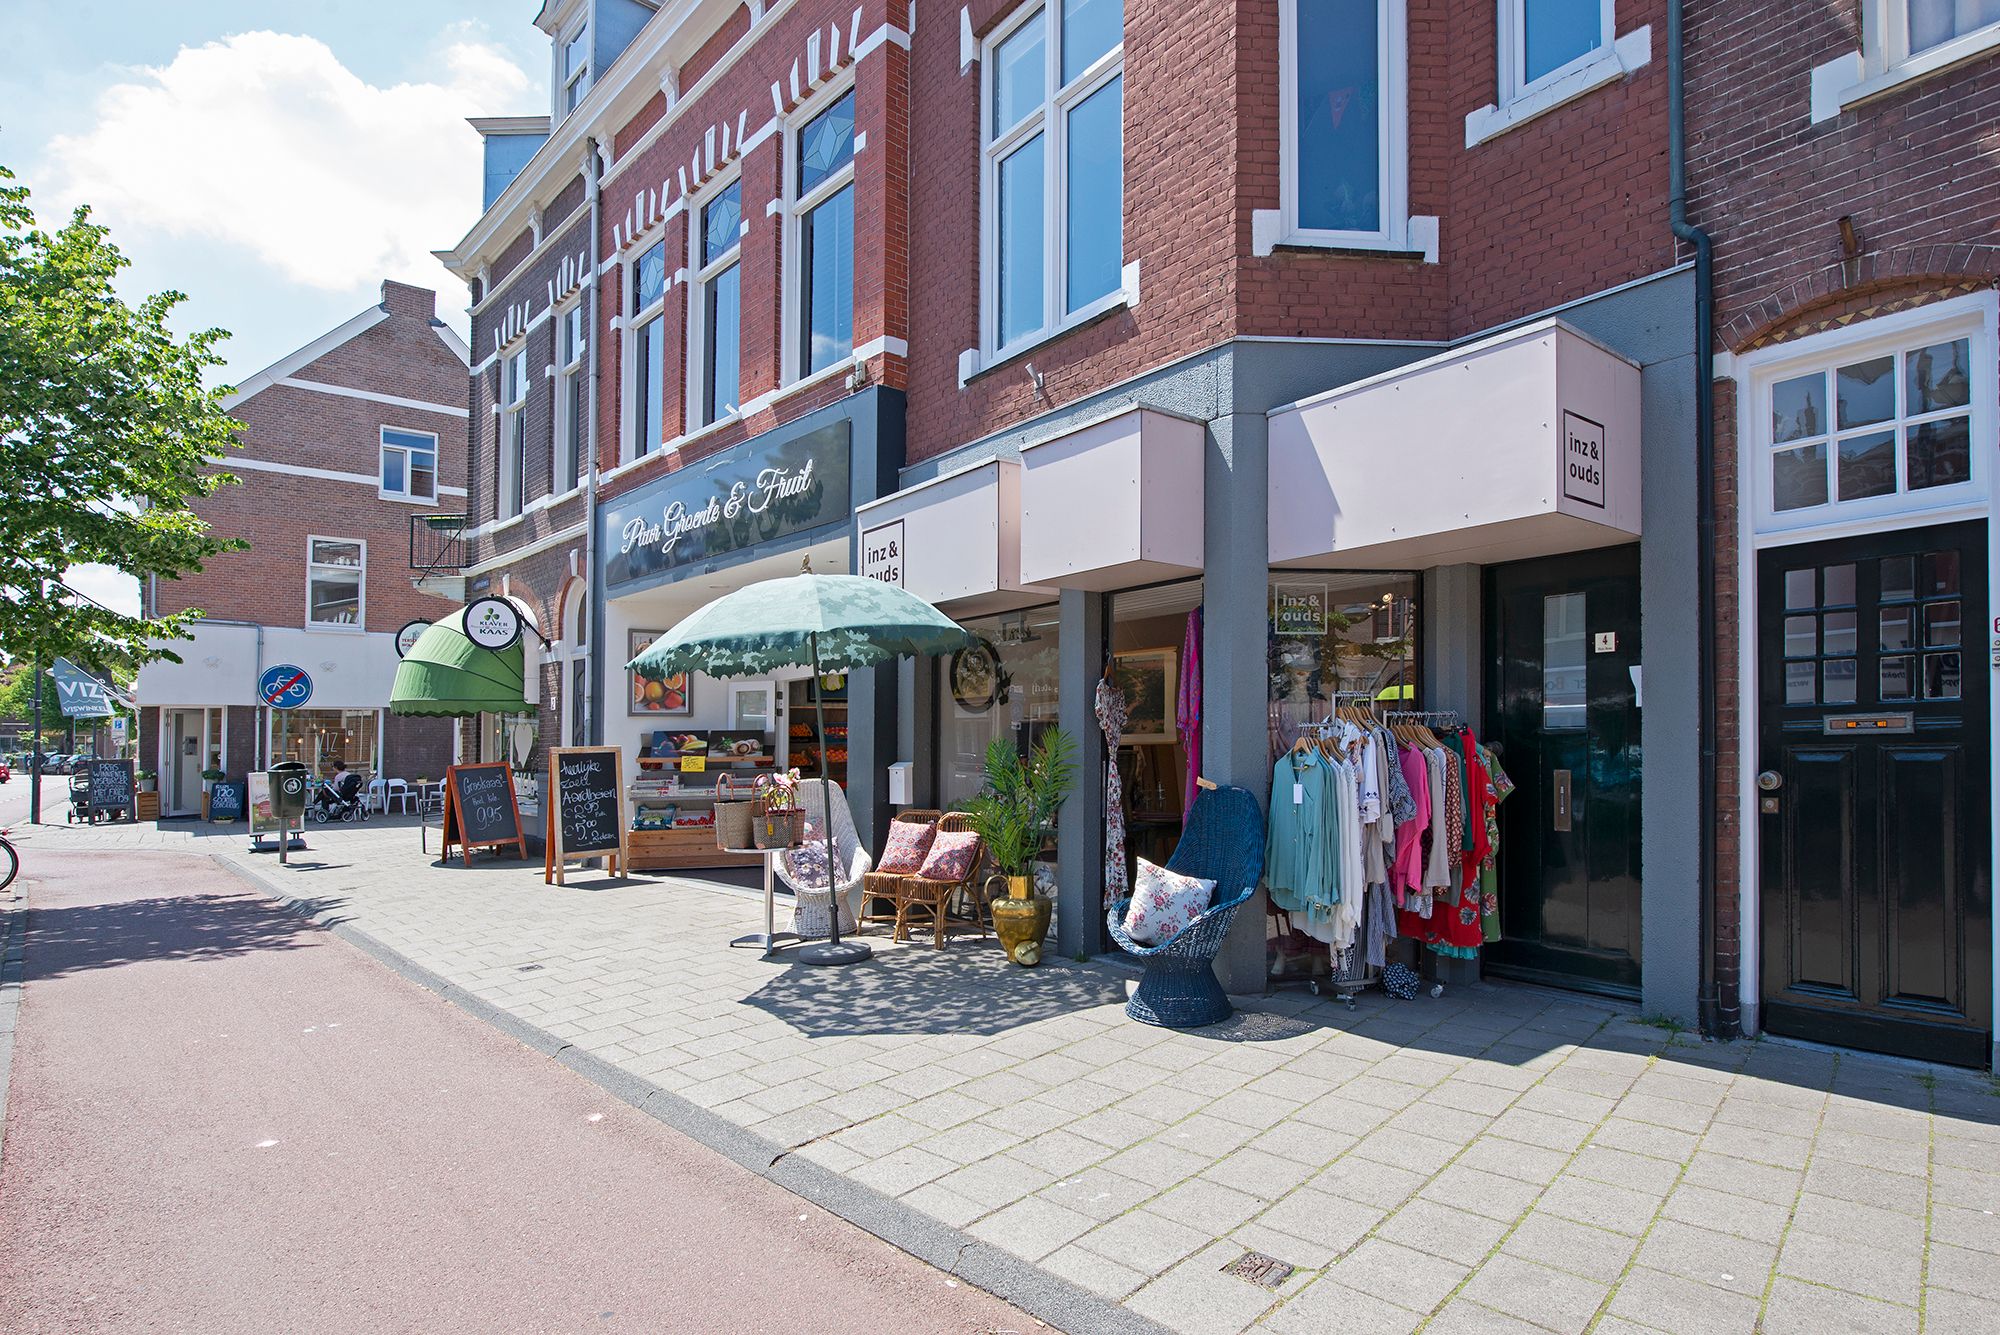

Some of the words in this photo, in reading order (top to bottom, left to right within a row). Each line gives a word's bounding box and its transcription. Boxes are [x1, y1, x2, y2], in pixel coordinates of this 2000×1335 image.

[1569, 463, 1600, 486] ouds
[662, 496, 720, 554] Groente
[724, 481, 746, 519] &
[748, 459, 813, 513] Fruit
[1282, 610, 1321, 622] ouds
[479, 628, 509, 636] KAAS
[57, 681, 104, 698] VIZ
